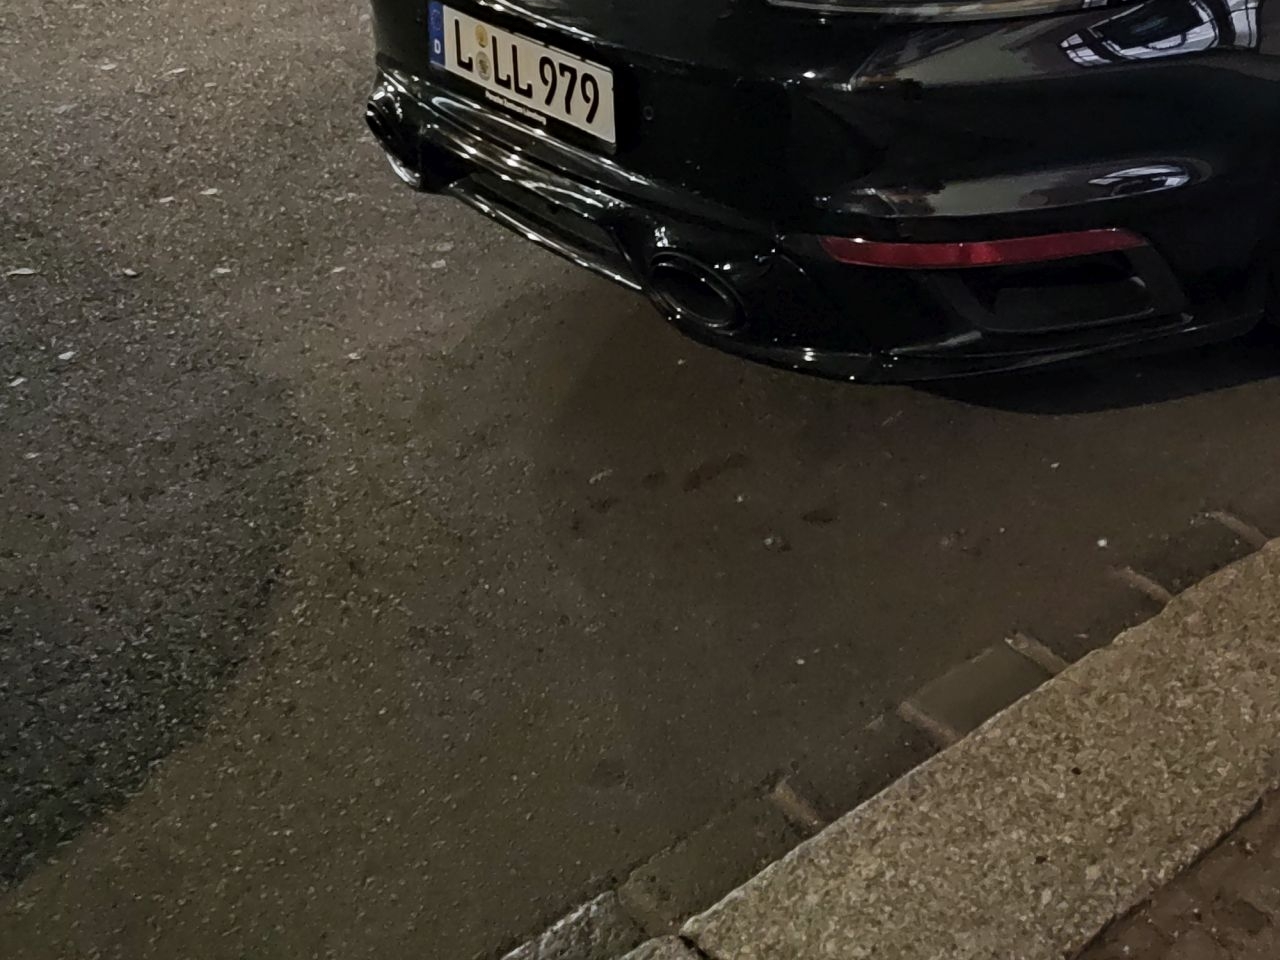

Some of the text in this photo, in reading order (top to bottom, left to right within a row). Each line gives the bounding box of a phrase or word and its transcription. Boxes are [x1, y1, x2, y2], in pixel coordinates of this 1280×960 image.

[454, 19, 474, 72] L
[491, 35, 533, 99] LL
[538, 55, 600, 124] 979
